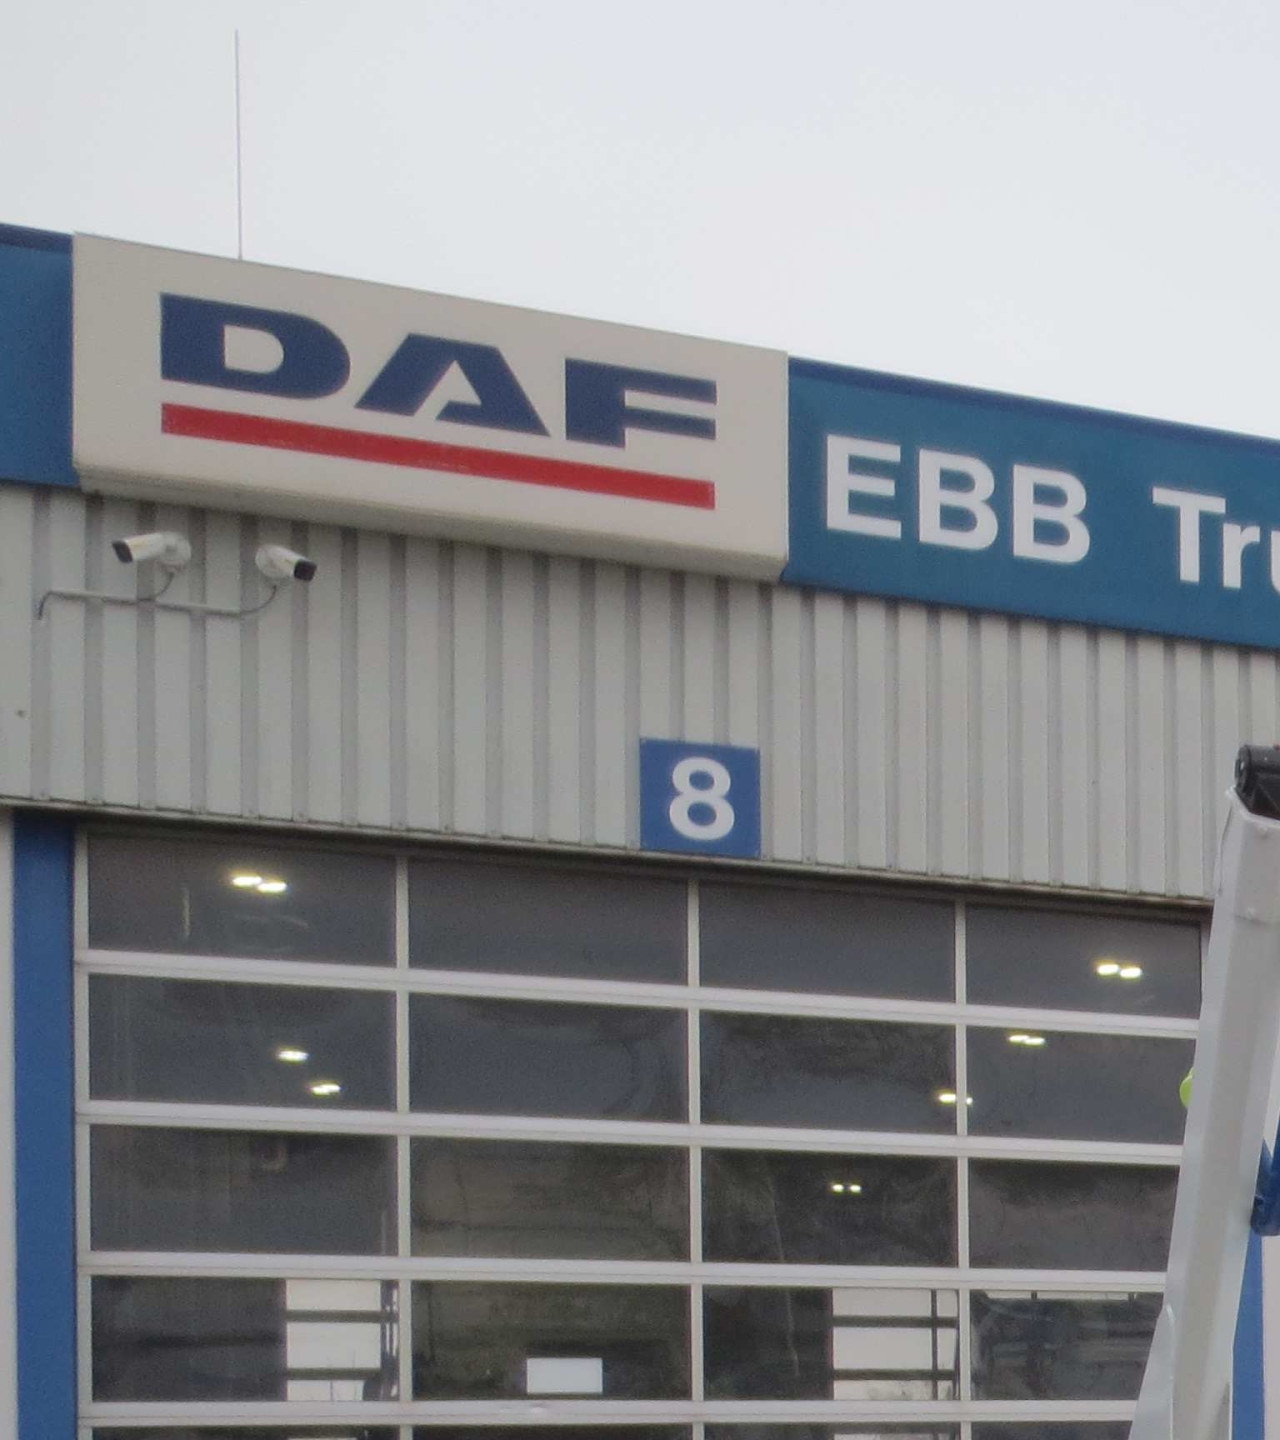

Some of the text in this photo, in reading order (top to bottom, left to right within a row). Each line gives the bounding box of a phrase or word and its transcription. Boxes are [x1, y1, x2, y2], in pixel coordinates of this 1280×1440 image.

[159, 291, 718, 450] DAF
[826, 434, 1090, 563] EBB
[669, 757, 735, 841] 8
